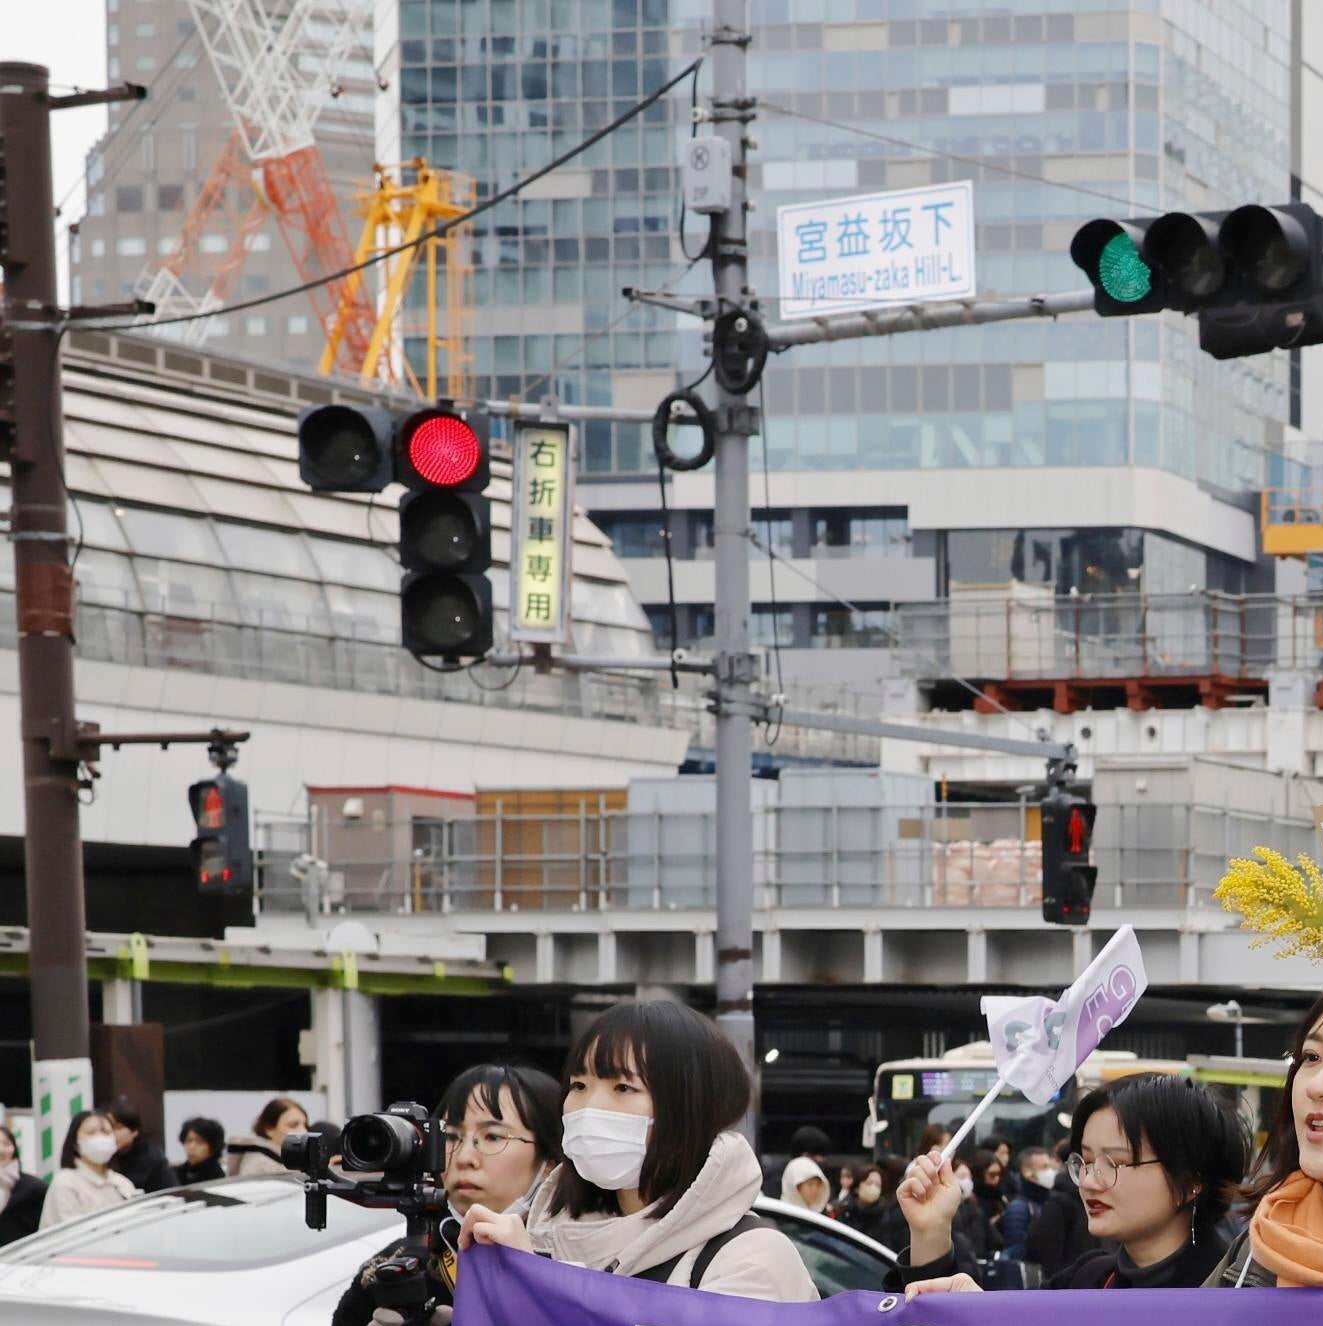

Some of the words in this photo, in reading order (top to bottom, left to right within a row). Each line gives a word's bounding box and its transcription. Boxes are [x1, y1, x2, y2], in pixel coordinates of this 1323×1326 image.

[796, 200, 954, 264] 宮益坂下
[792, 258, 909, 306] Miyamasu-zaka
[914, 252, 962, 286] Hill-L.
[525, 440, 558, 620] 右折車専用
